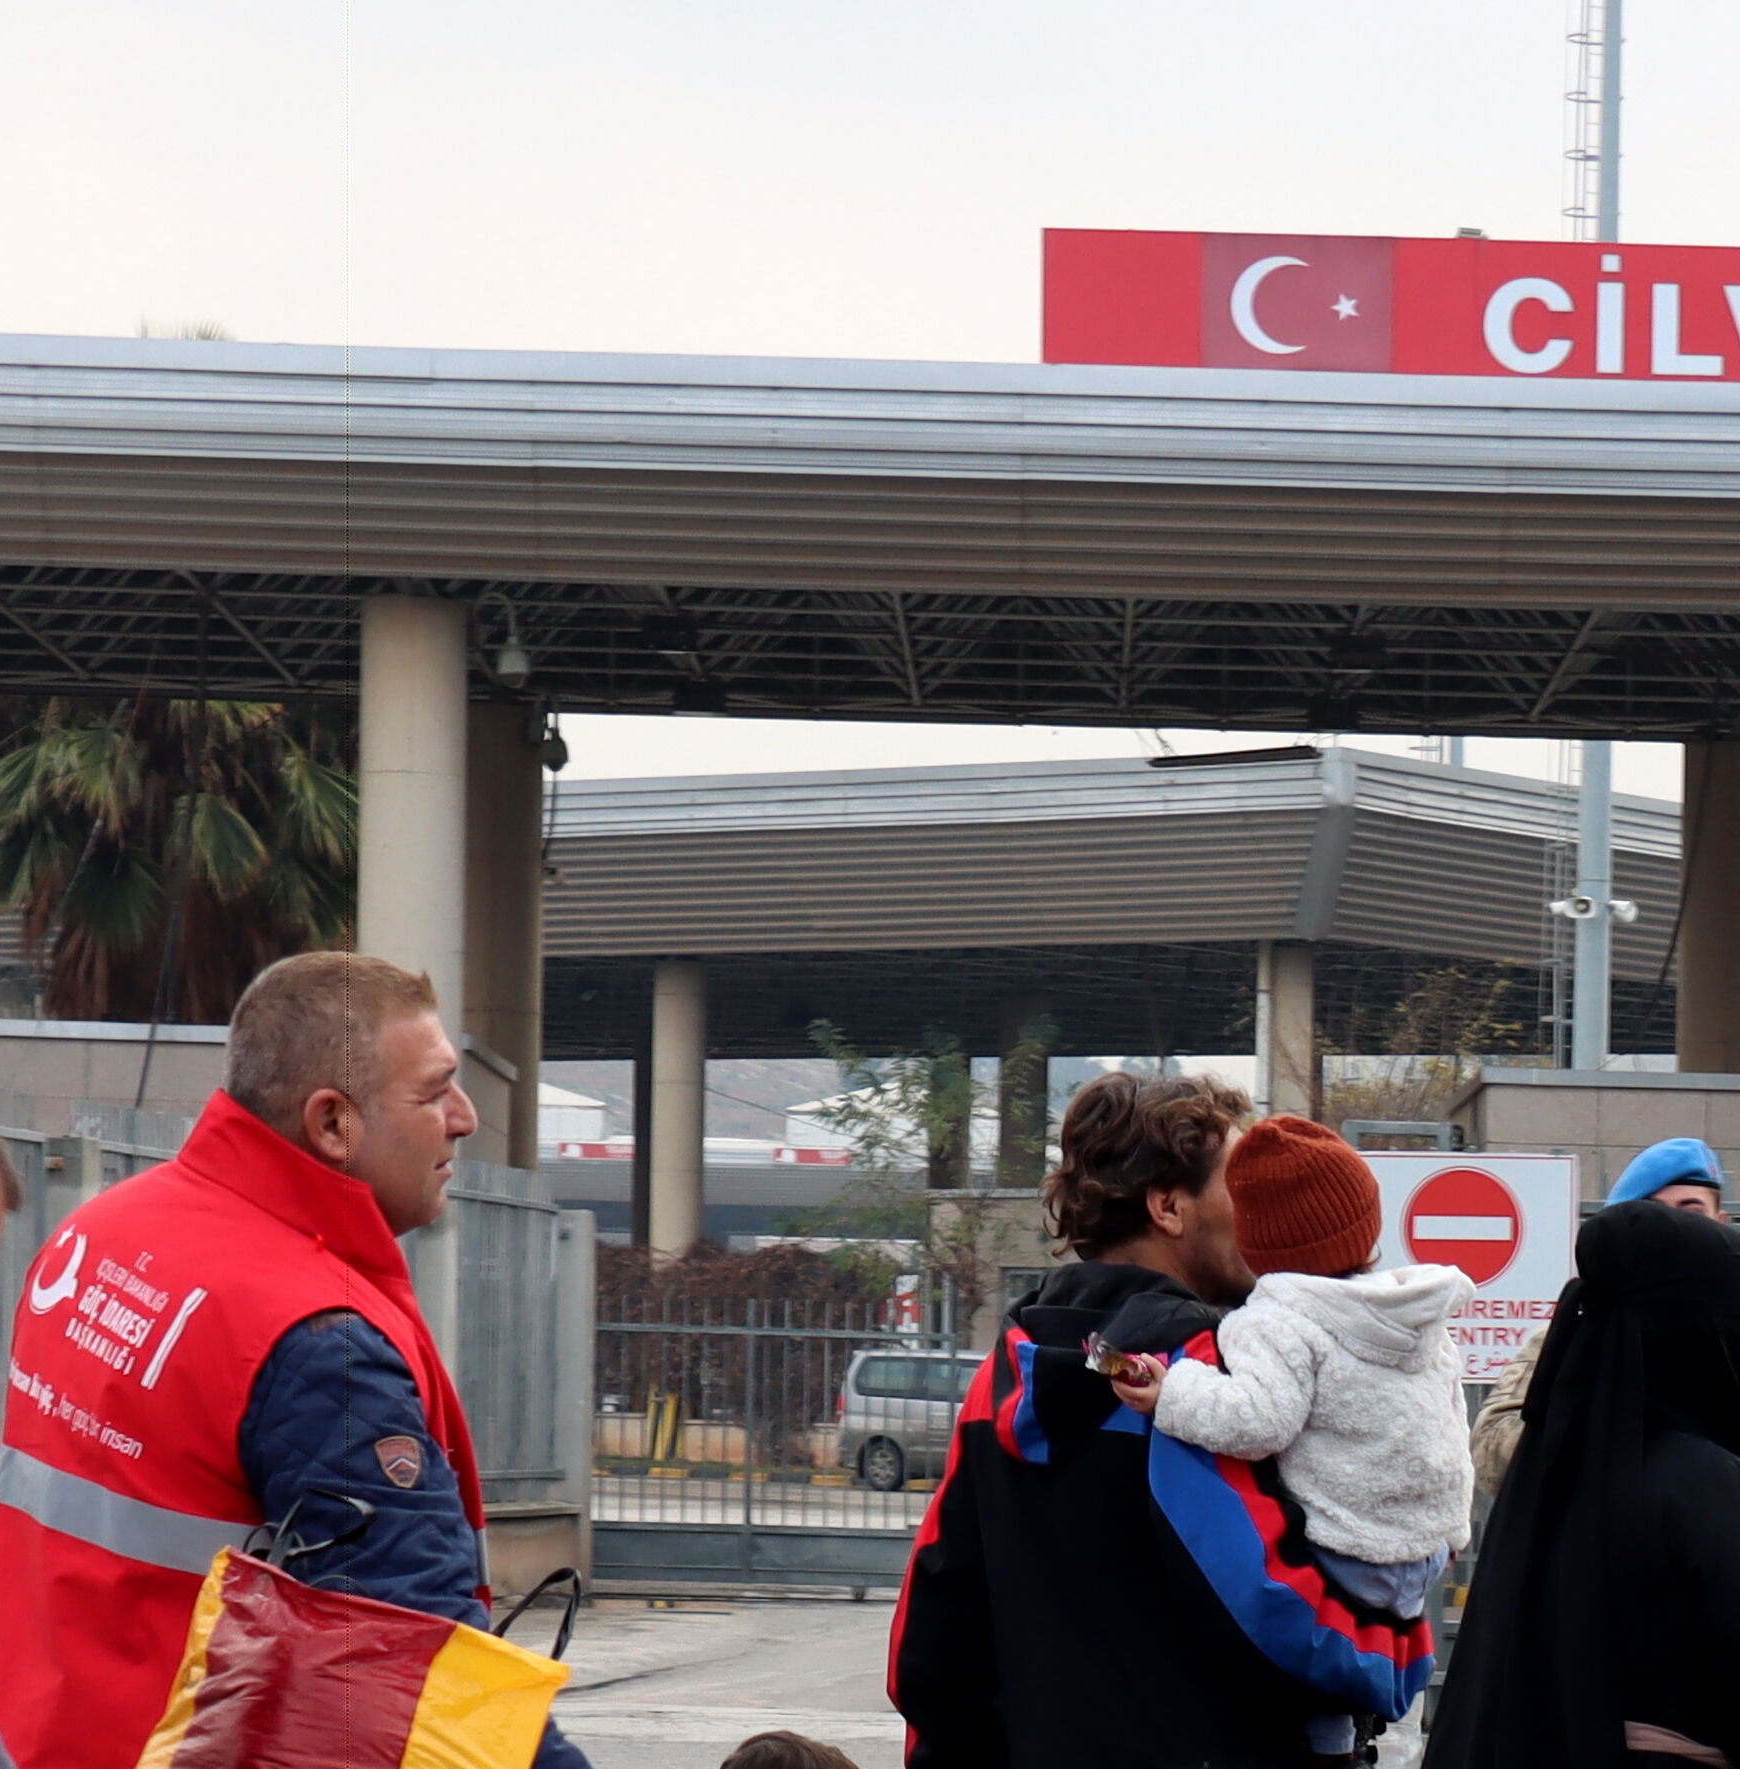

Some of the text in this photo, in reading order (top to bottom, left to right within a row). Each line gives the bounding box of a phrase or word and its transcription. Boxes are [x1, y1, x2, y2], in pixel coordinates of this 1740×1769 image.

[65, 1317, 136, 1376] BAŞKANLIĞI
[98, 1293, 156, 1348] İDARESİ
[100, 1420, 143, 1460] insan
